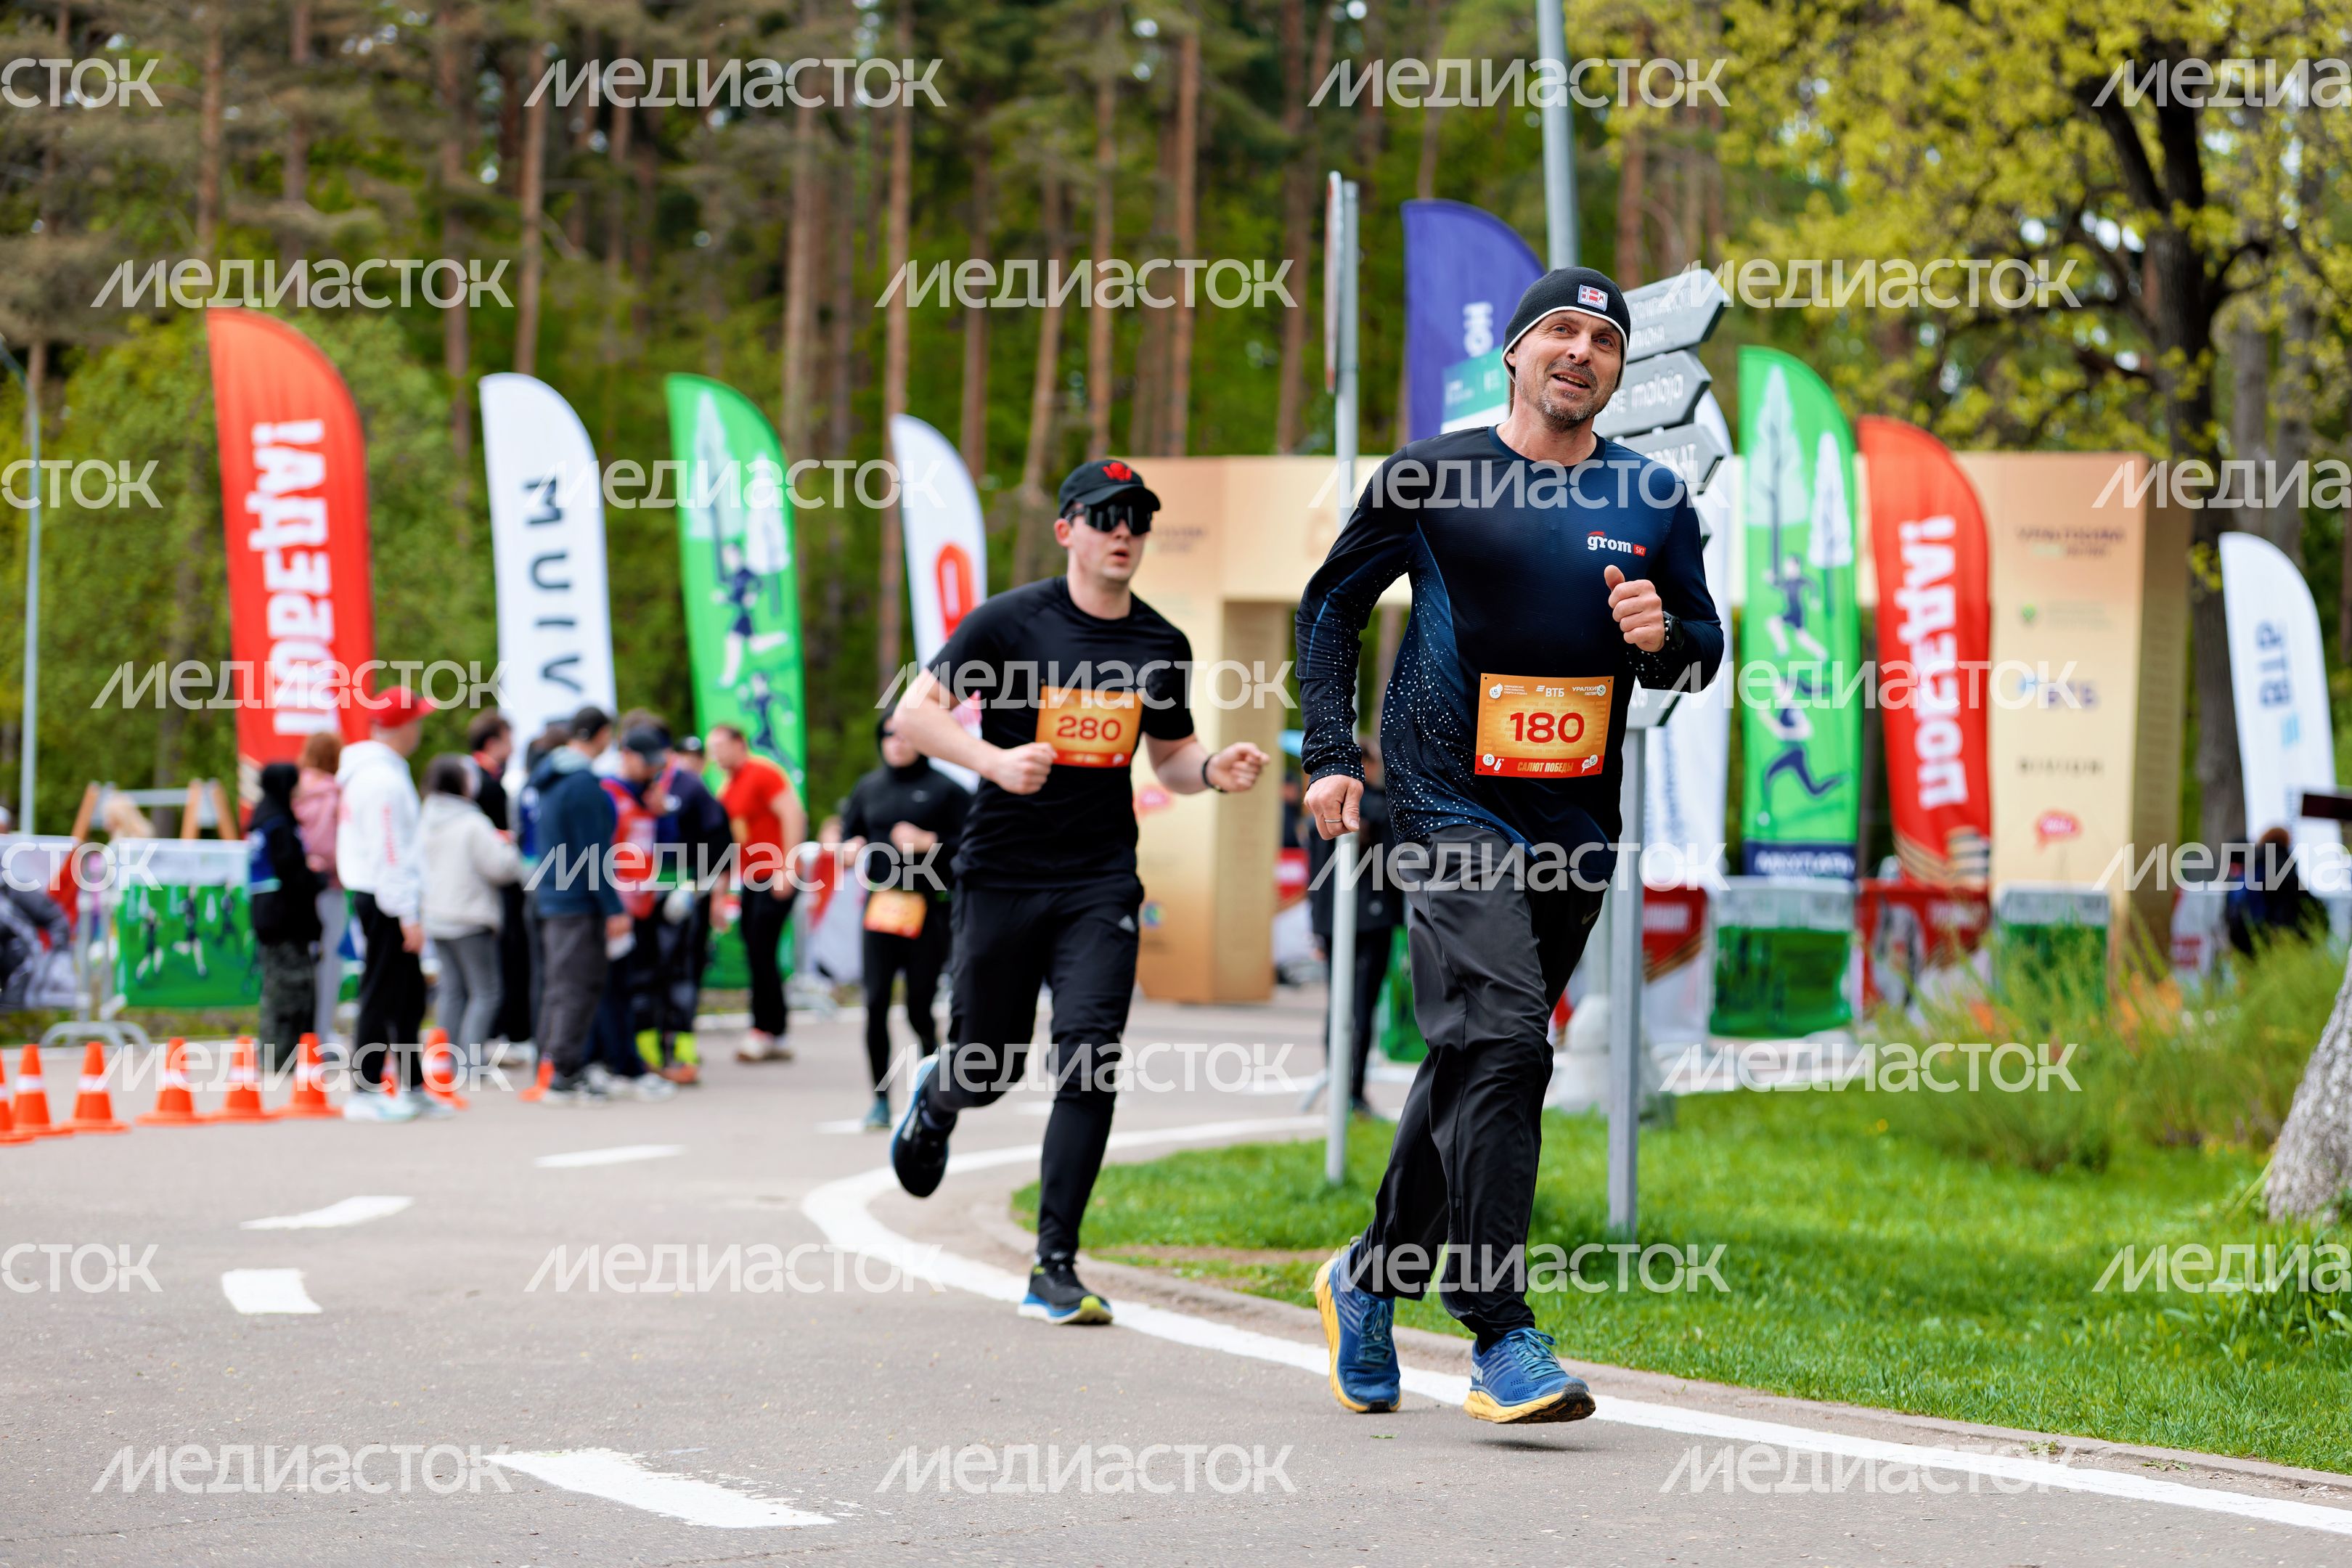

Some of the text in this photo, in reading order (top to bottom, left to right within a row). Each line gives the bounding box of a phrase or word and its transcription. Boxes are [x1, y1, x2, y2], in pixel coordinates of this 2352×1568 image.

[1588, 536, 1631, 553] grom
[524, 480, 584, 693] MUIV
[1545, 687, 1564, 698] ВТБ
[1056, 715, 1122, 742] 280
[1510, 712, 1585, 743] 180
[1517, 762, 1574, 774] САЛЮТ ПОБЕДЫ
